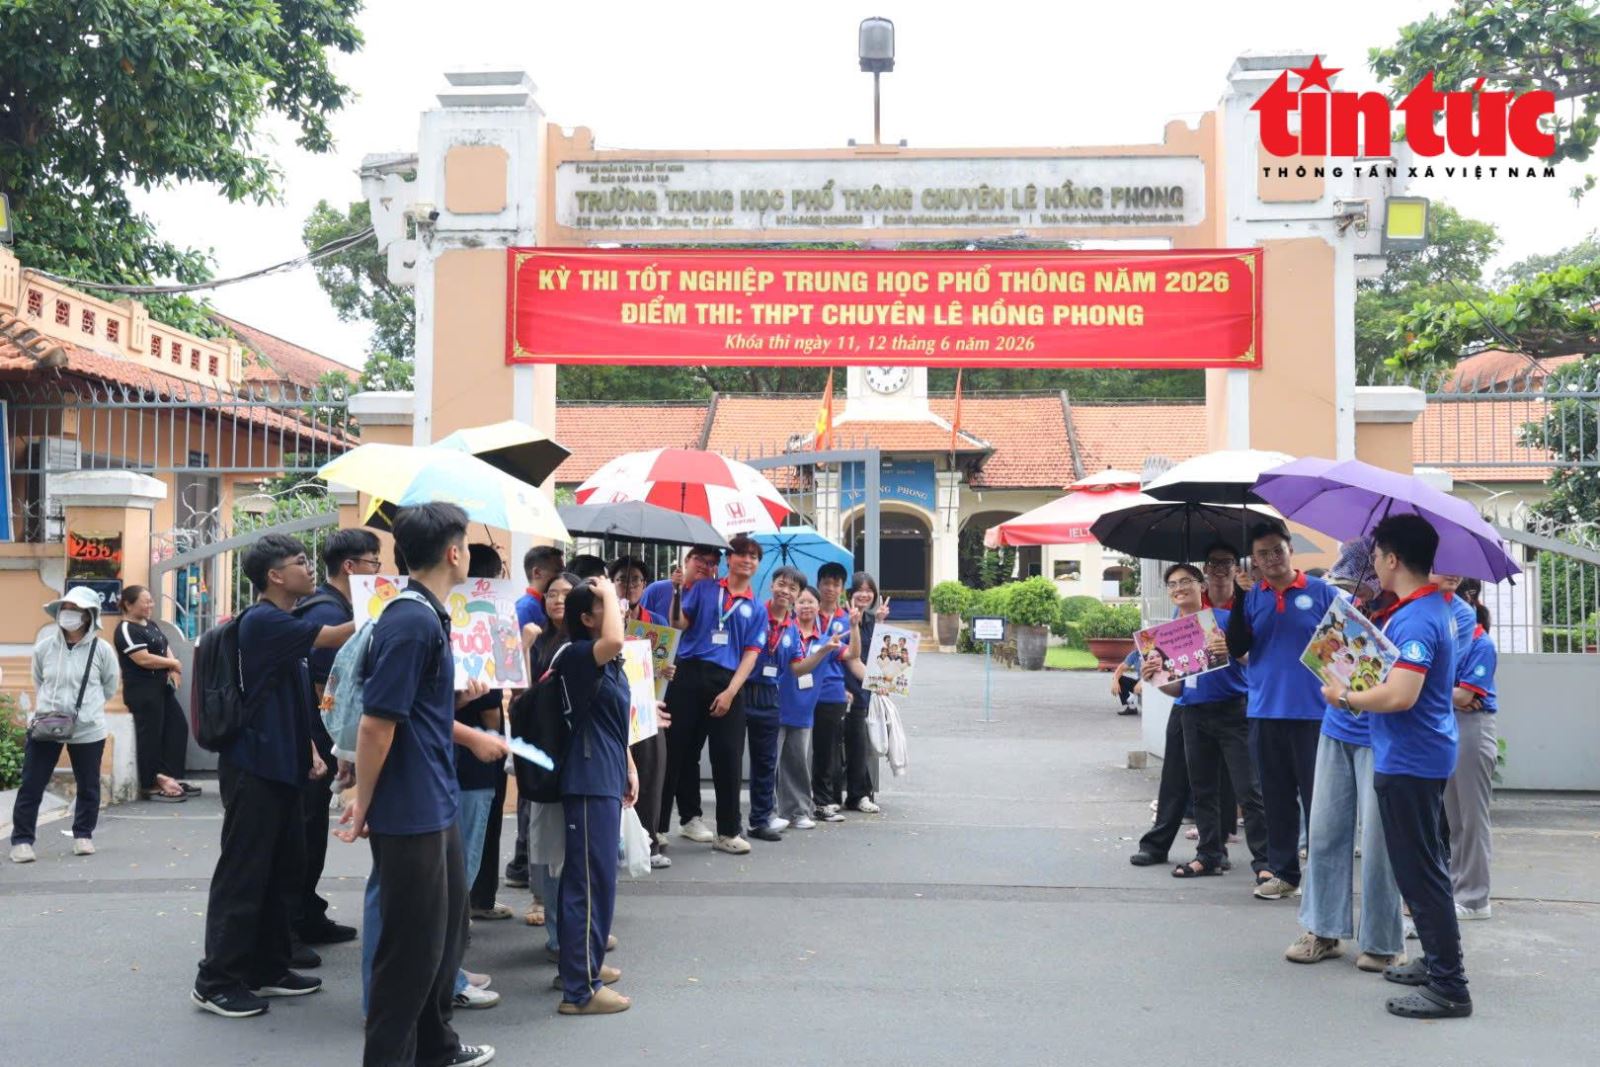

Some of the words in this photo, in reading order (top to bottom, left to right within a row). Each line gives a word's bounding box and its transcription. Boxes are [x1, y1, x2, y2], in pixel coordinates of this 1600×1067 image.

[575, 186, 658, 213] TRƯỜNG
[665, 189, 734, 213] TRUNG
[740, 188, 785, 214] HỌC
[792, 178, 836, 212] PHỔ
[842, 184, 913, 211] THÔNG
[921, 183, 1006, 211] CHUYÊN
[1011, 183, 1038, 210] LÊ
[1044, 179, 1104, 210] HỒNG
[1110, 186, 1185, 210] PHONG
[538, 264, 570, 291] KỲ
[579, 269, 618, 291] THI
[626, 262, 670, 292] TỐT
[679, 266, 775, 297] NGHIỆP
[783, 271, 868, 292] TRUNG
[876, 271, 929, 297] HỌC
[937, 263, 992, 293] PHỔ
[999, 265, 1086, 293] THÔNG
[1094, 264, 1157, 293] NĂM
[1164, 271, 1230, 293] 2026
[621, 294, 687, 325] ĐIỂM
[695, 303, 742, 325] THI:
[750, 303, 814, 325] THPT
[821, 299, 925, 326] CHUYÊN
[933, 299, 963, 326] LÊ
[972, 297, 1044, 326] HỒNG
[1053, 304, 1144, 326] PHONG
[725, 334, 763, 350] Khóa
[768, 334, 791, 350] thi
[794, 336, 831, 354] ngày
[836, 335, 860, 352] 11,
[867, 335, 888, 351] 12
[891, 335, 934, 355] tháng
[940, 335, 950, 351] 6
[955, 336, 990, 351] năm
[995, 335, 1035, 352] 2026
[896, 485, 929, 500] PHONG
[1069, 527, 1091, 539] IELT
